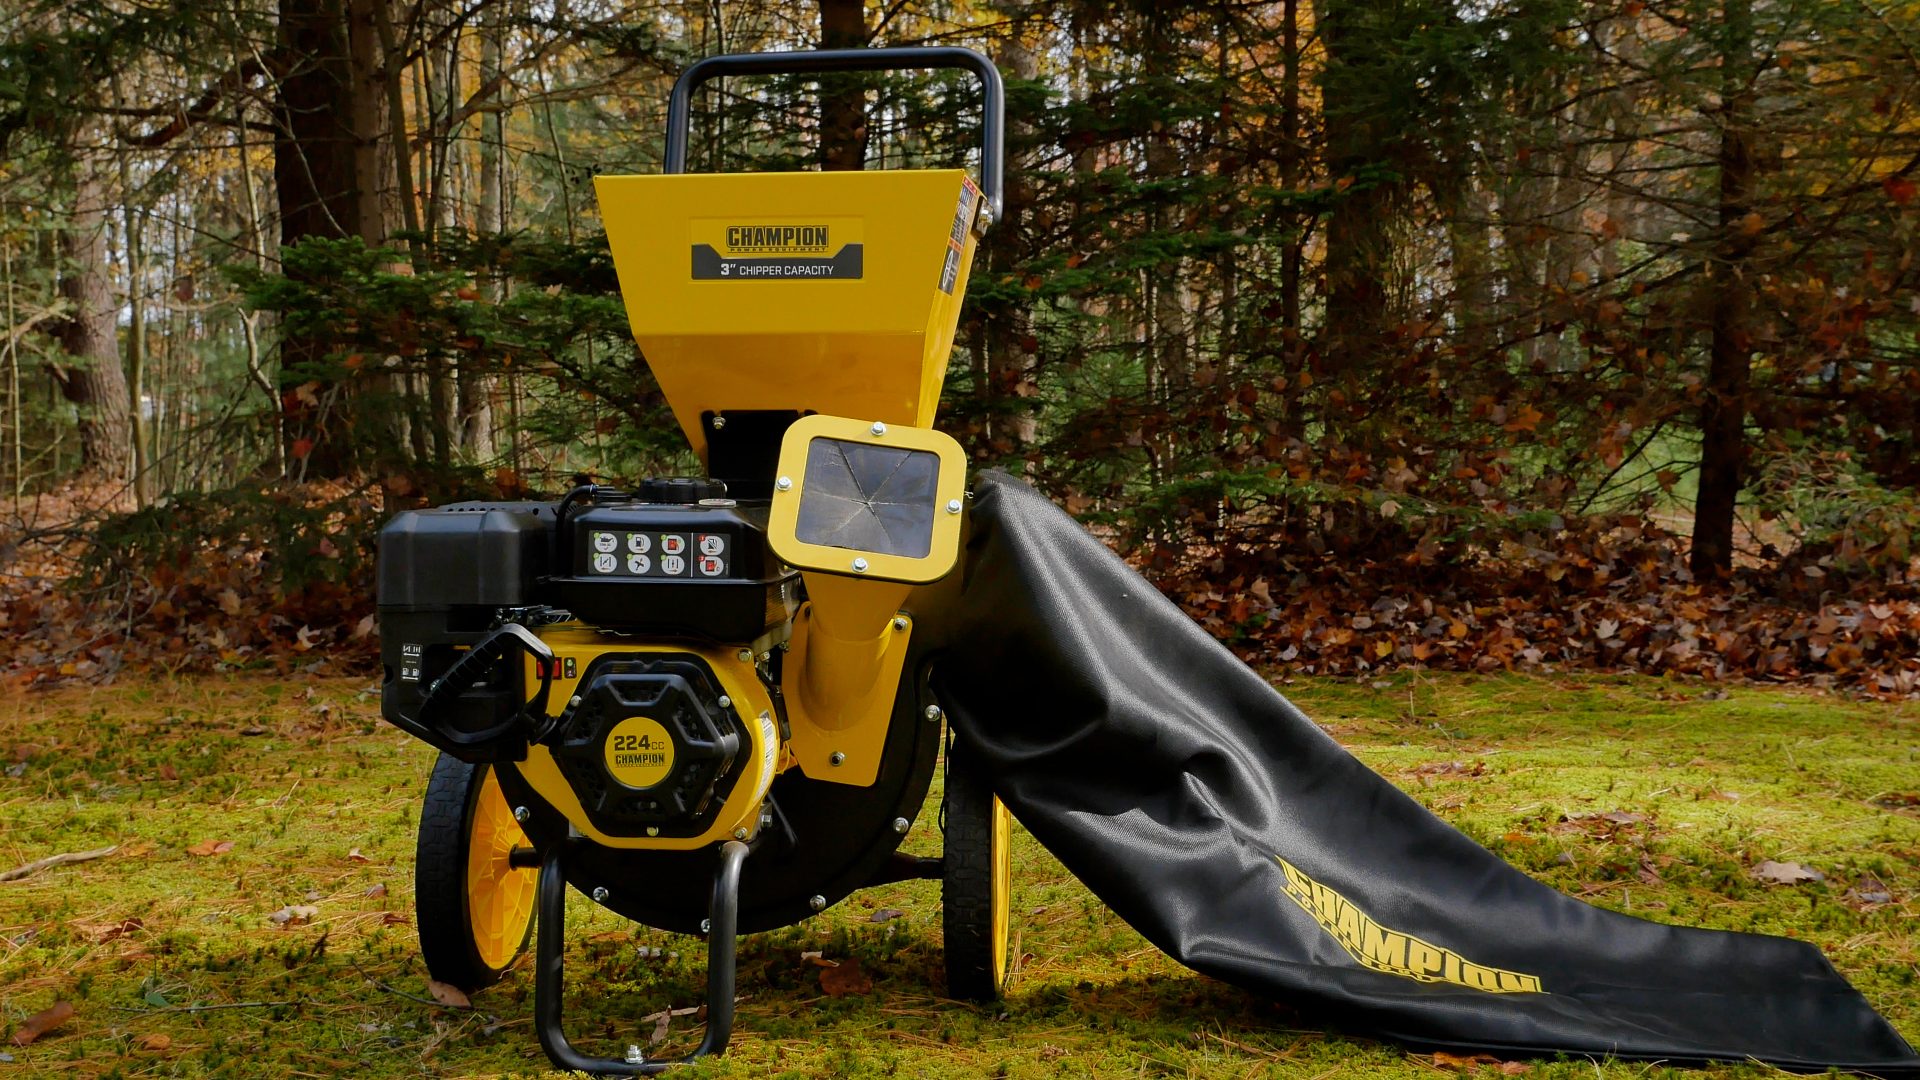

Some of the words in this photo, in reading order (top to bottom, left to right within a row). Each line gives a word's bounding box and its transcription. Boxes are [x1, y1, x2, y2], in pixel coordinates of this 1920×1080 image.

[727, 226, 828, 247] CHAMPION
[739, 265, 782, 276] CHIPPER
[784, 265, 834, 276] CAPACITY
[615, 753, 665, 765] CHAMPION
[1277, 858, 1541, 993] CHAMPION
